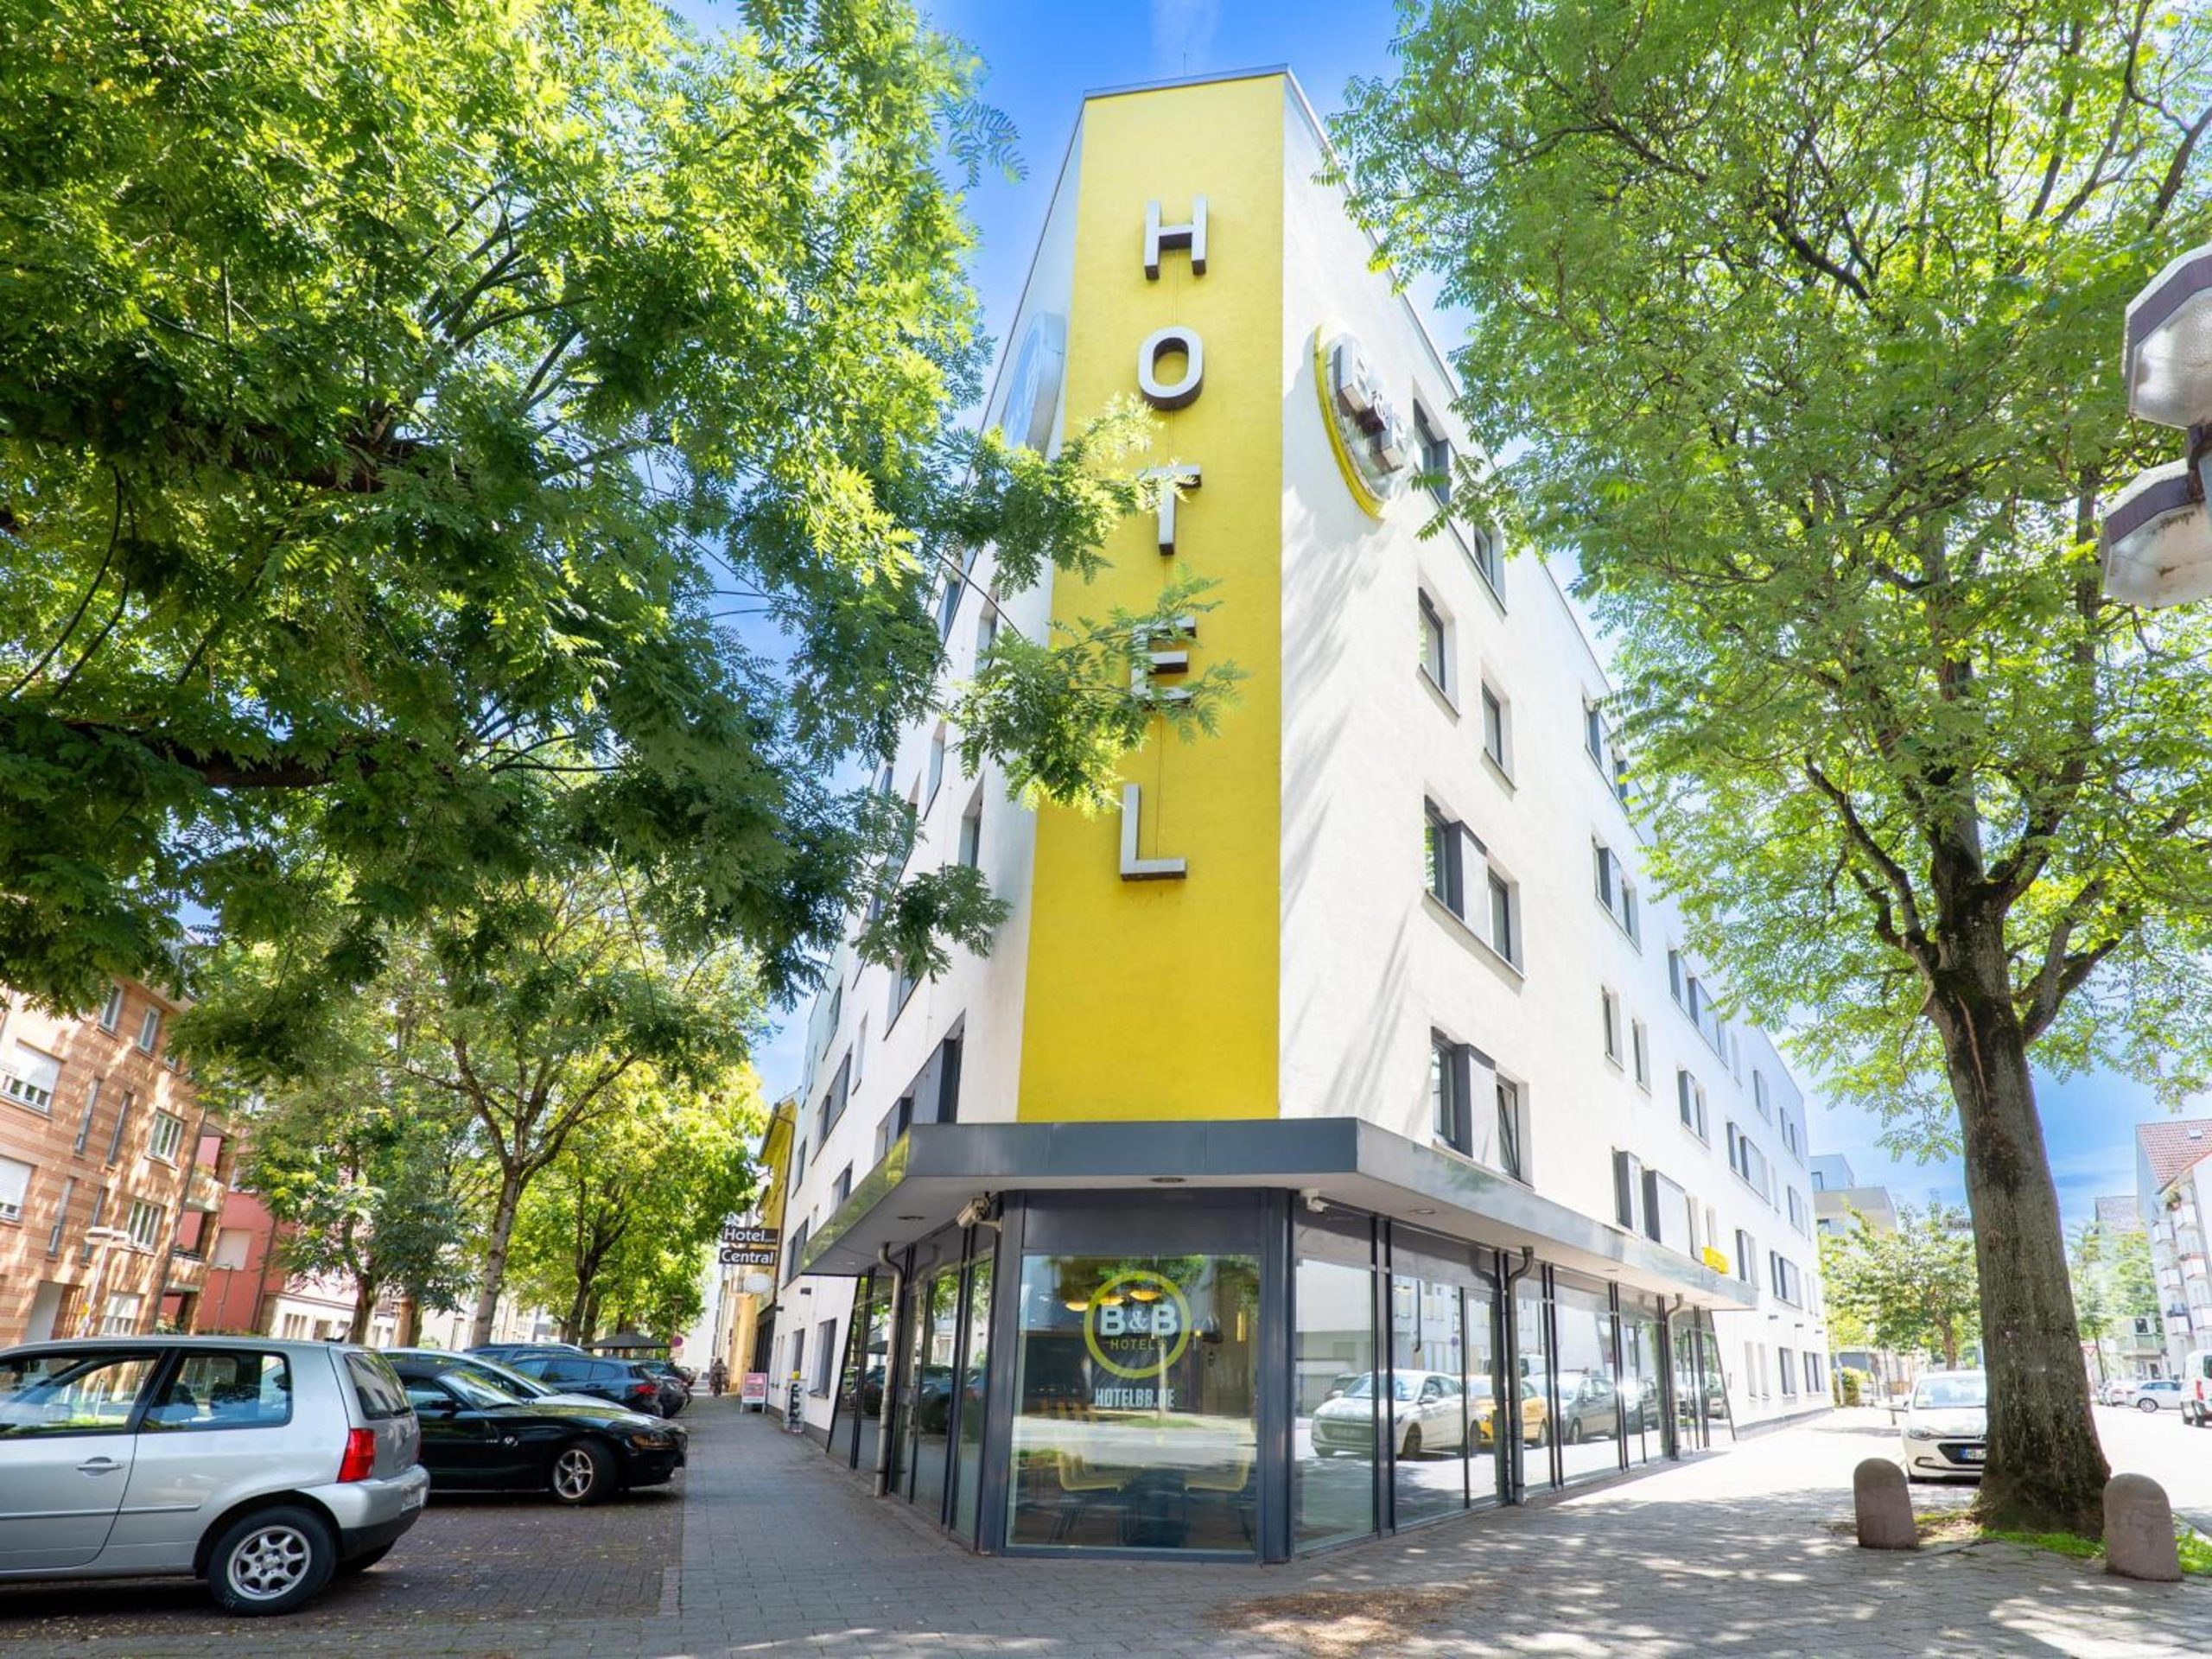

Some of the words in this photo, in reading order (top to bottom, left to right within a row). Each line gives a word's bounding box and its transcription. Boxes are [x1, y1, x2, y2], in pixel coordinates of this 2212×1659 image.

[1120, 195, 1208, 880] HOTEL
[723, 1228, 766, 1243] Hotel
[721, 1249, 774, 1264] Central
[1100, 1304, 1177, 1336] B&B
